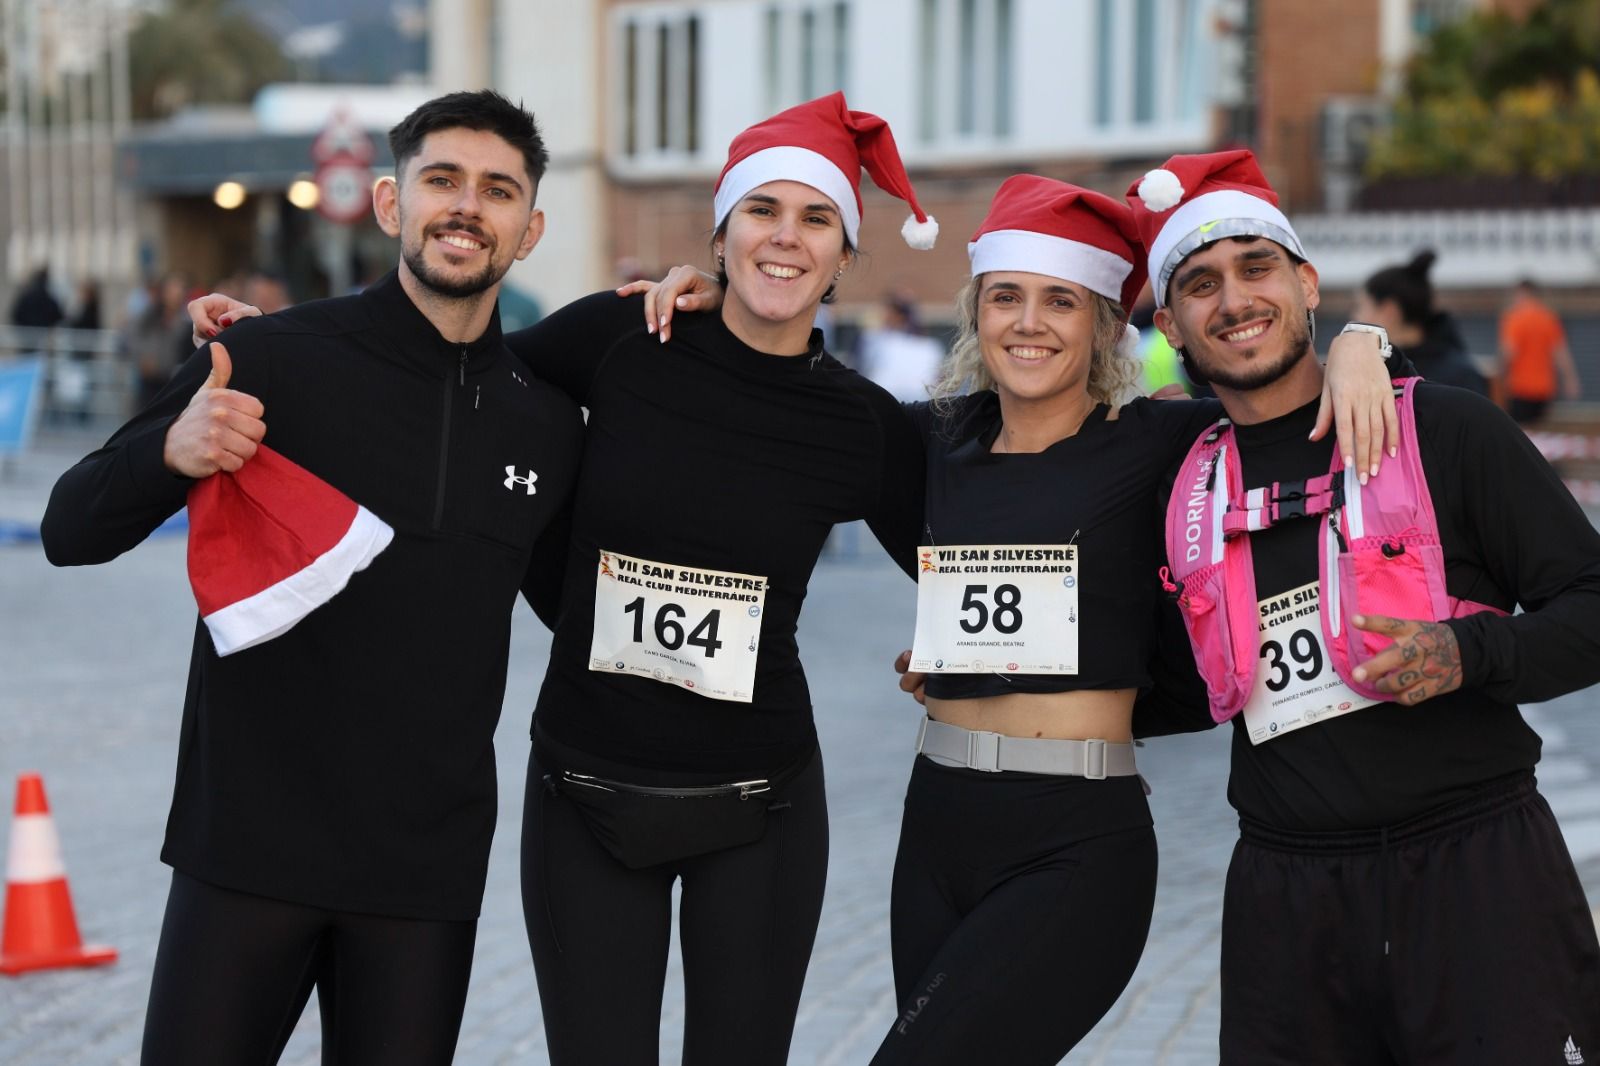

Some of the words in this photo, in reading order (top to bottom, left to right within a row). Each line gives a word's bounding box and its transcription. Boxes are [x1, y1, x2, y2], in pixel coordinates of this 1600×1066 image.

[938, 550, 956, 561] VII
[960, 550, 989, 561] SAN
[993, 549, 1075, 561] SILVESTRE
[938, 565, 962, 574] REAL
[964, 565, 989, 573] CLUB
[991, 563, 1072, 573] MEDITERRÁNEO
[617, 574, 643, 587] REAL
[645, 581, 672, 592] CLUB
[675, 585, 758, 603] MEDITERRÁNEO
[618, 559, 638, 573] VII
[641, 564, 675, 580] SAN
[678, 571, 763, 591] SILVESTRE
[960, 584, 1023, 635] 58
[1260, 597, 1291, 617] SAN
[1268, 613, 1293, 627] CLUB
[624, 596, 723, 658] 164
[1259, 628, 1337, 692] 39
[897, 995, 930, 1036] FILA
